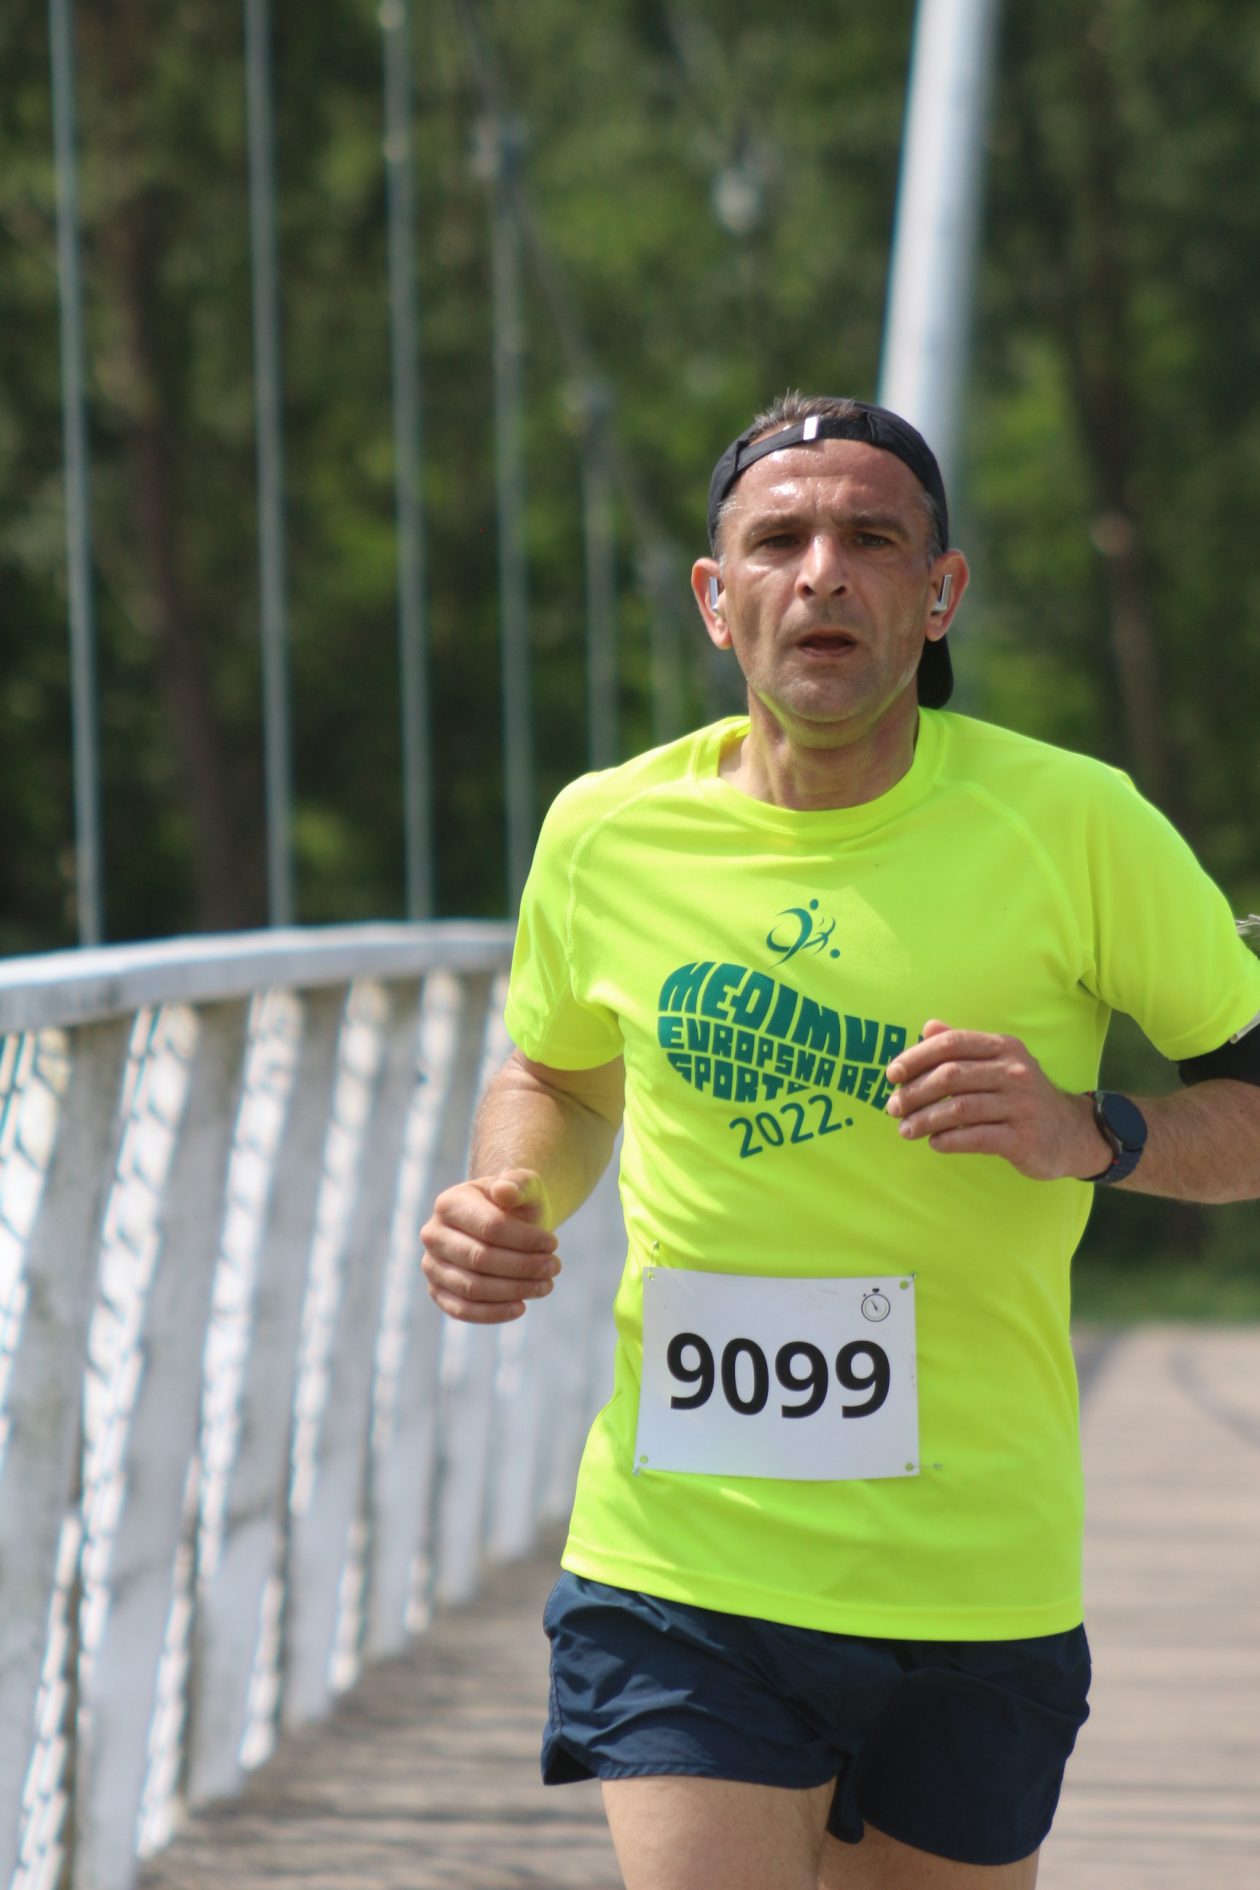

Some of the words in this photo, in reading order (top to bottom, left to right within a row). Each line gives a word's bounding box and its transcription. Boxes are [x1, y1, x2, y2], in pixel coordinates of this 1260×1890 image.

[658, 961, 924, 1067] MEĐIMUR
[837, 1063, 897, 1111] REG
[729, 1094, 854, 1159] 2022.
[666, 1332, 891, 1419] 9099
